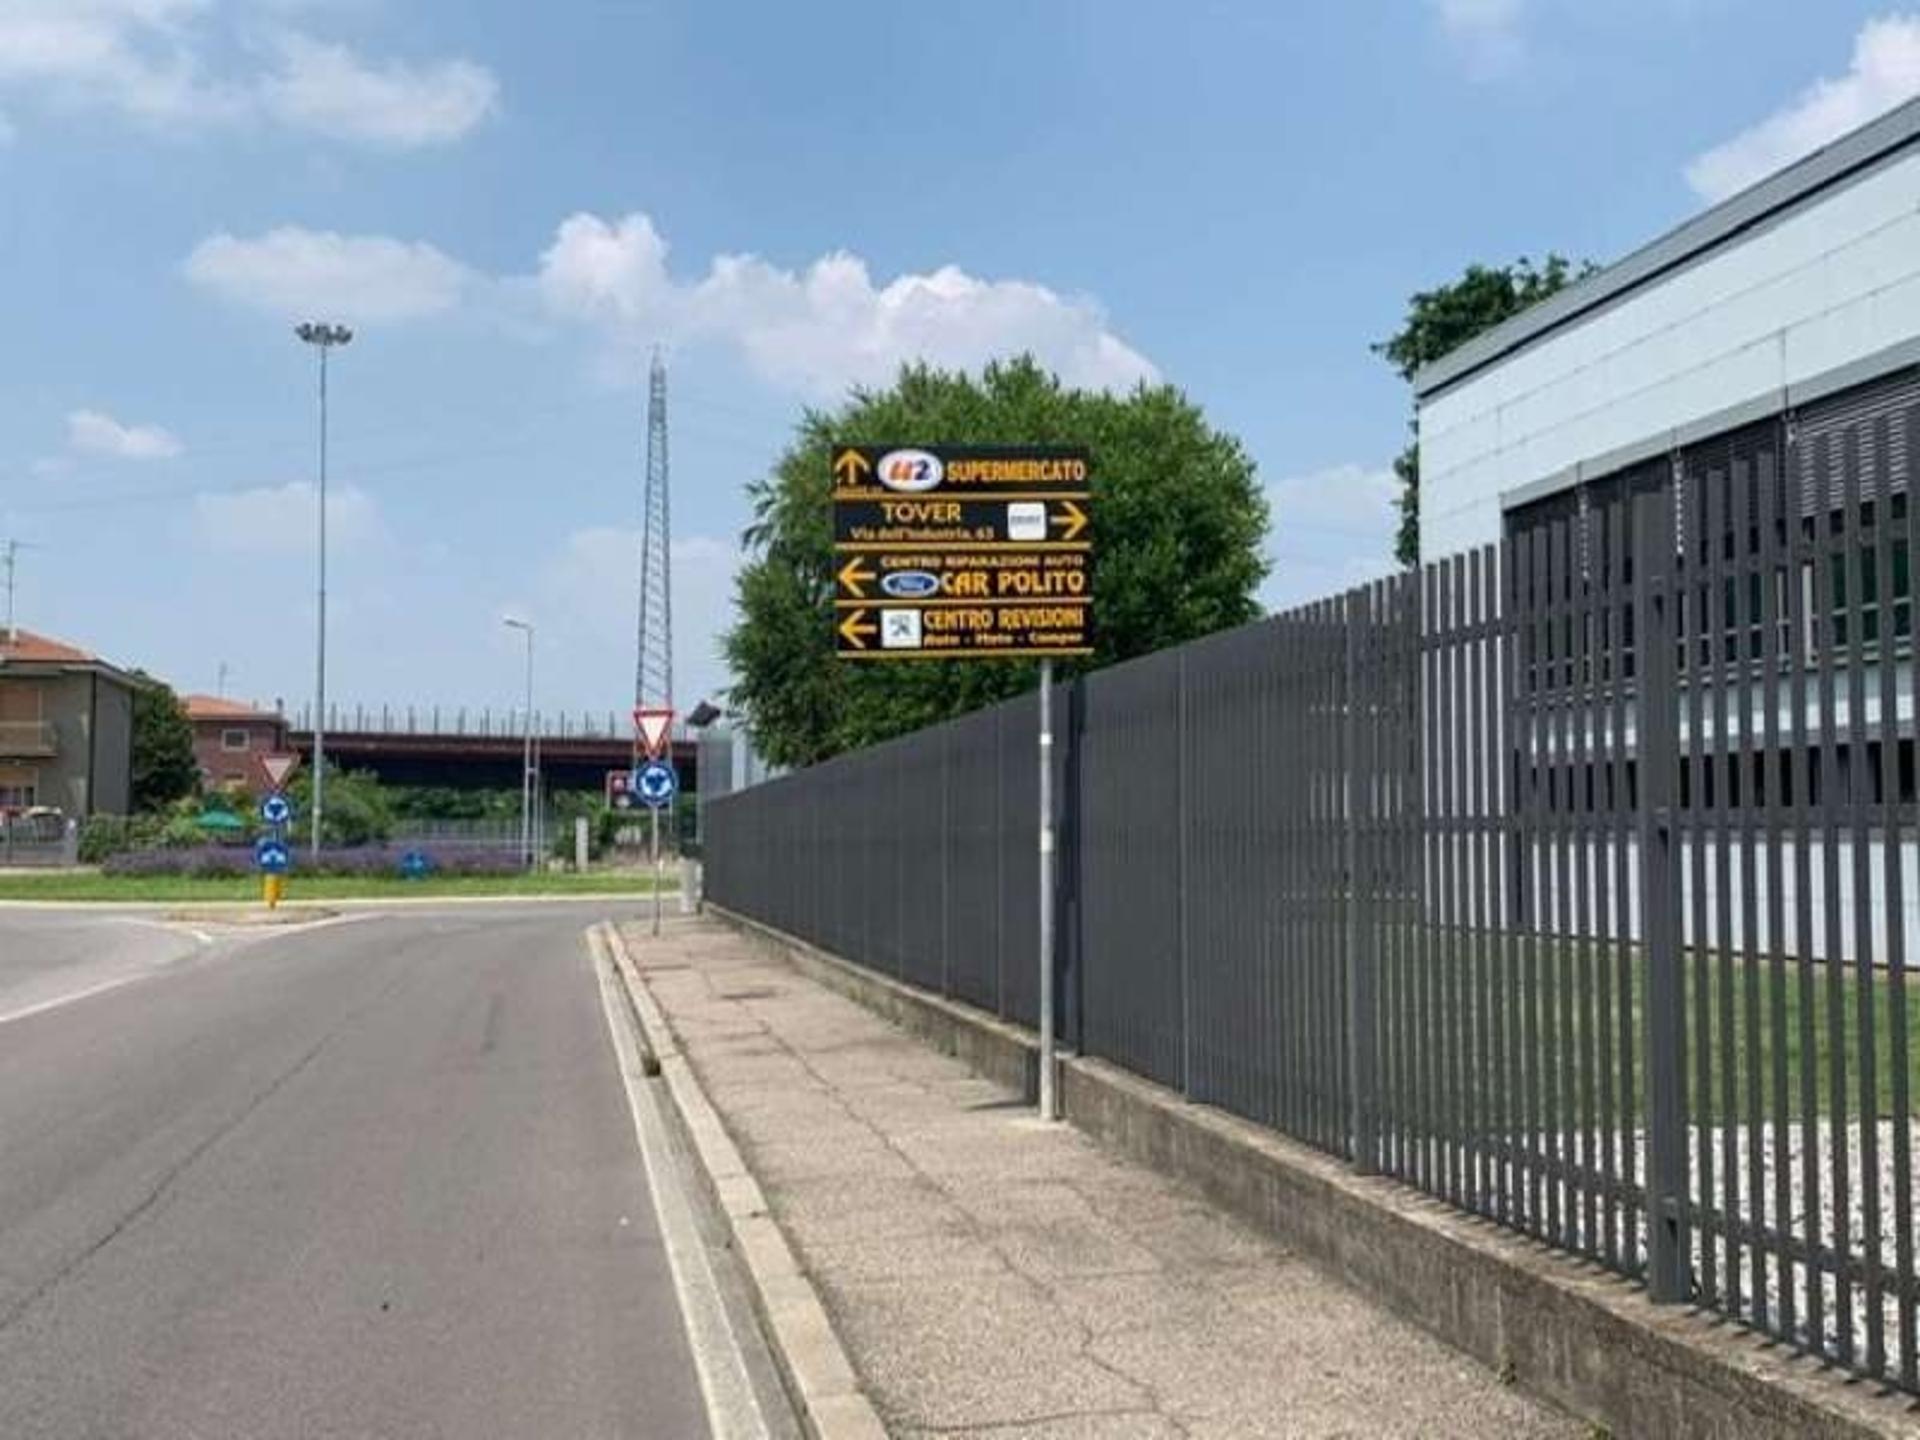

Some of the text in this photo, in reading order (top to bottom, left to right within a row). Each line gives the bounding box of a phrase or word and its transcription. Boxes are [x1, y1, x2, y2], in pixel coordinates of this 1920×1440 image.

[947, 460, 1086, 481] SUPERMERCATO
[883, 503, 961, 522] TOVER
[940, 571, 989, 595] CAR
[998, 571, 1085, 594] POLITO
[923, 608, 1084, 629] CENTRO REVISIONI
